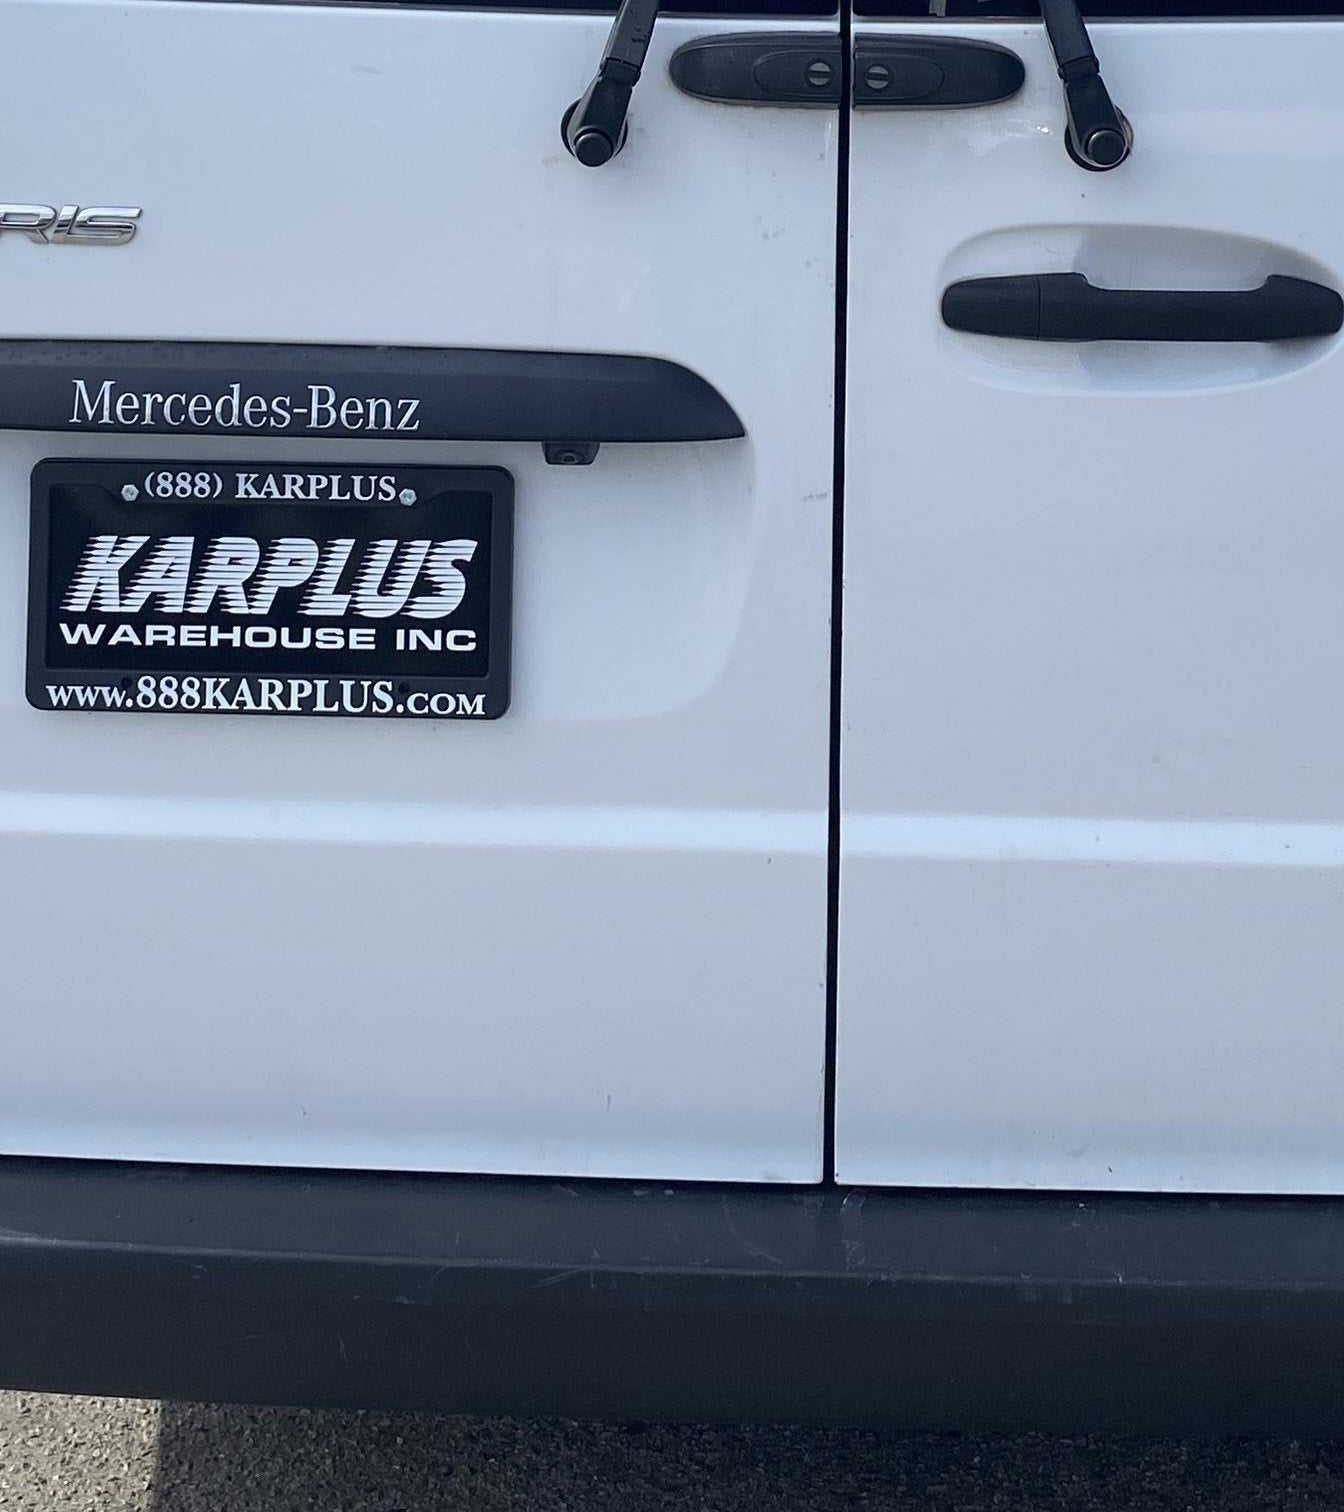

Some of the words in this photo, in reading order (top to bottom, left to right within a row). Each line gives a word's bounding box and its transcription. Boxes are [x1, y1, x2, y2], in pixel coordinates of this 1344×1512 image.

[68, 378, 421, 431] Mercedes-Benz
[143, 471, 223, 500] (888)
[234, 473, 397, 502] KARPLUS
[58, 534, 479, 620] KARPLUS
[58, 623, 376, 651] WAREHOUSE
[395, 628, 477, 652] INC
